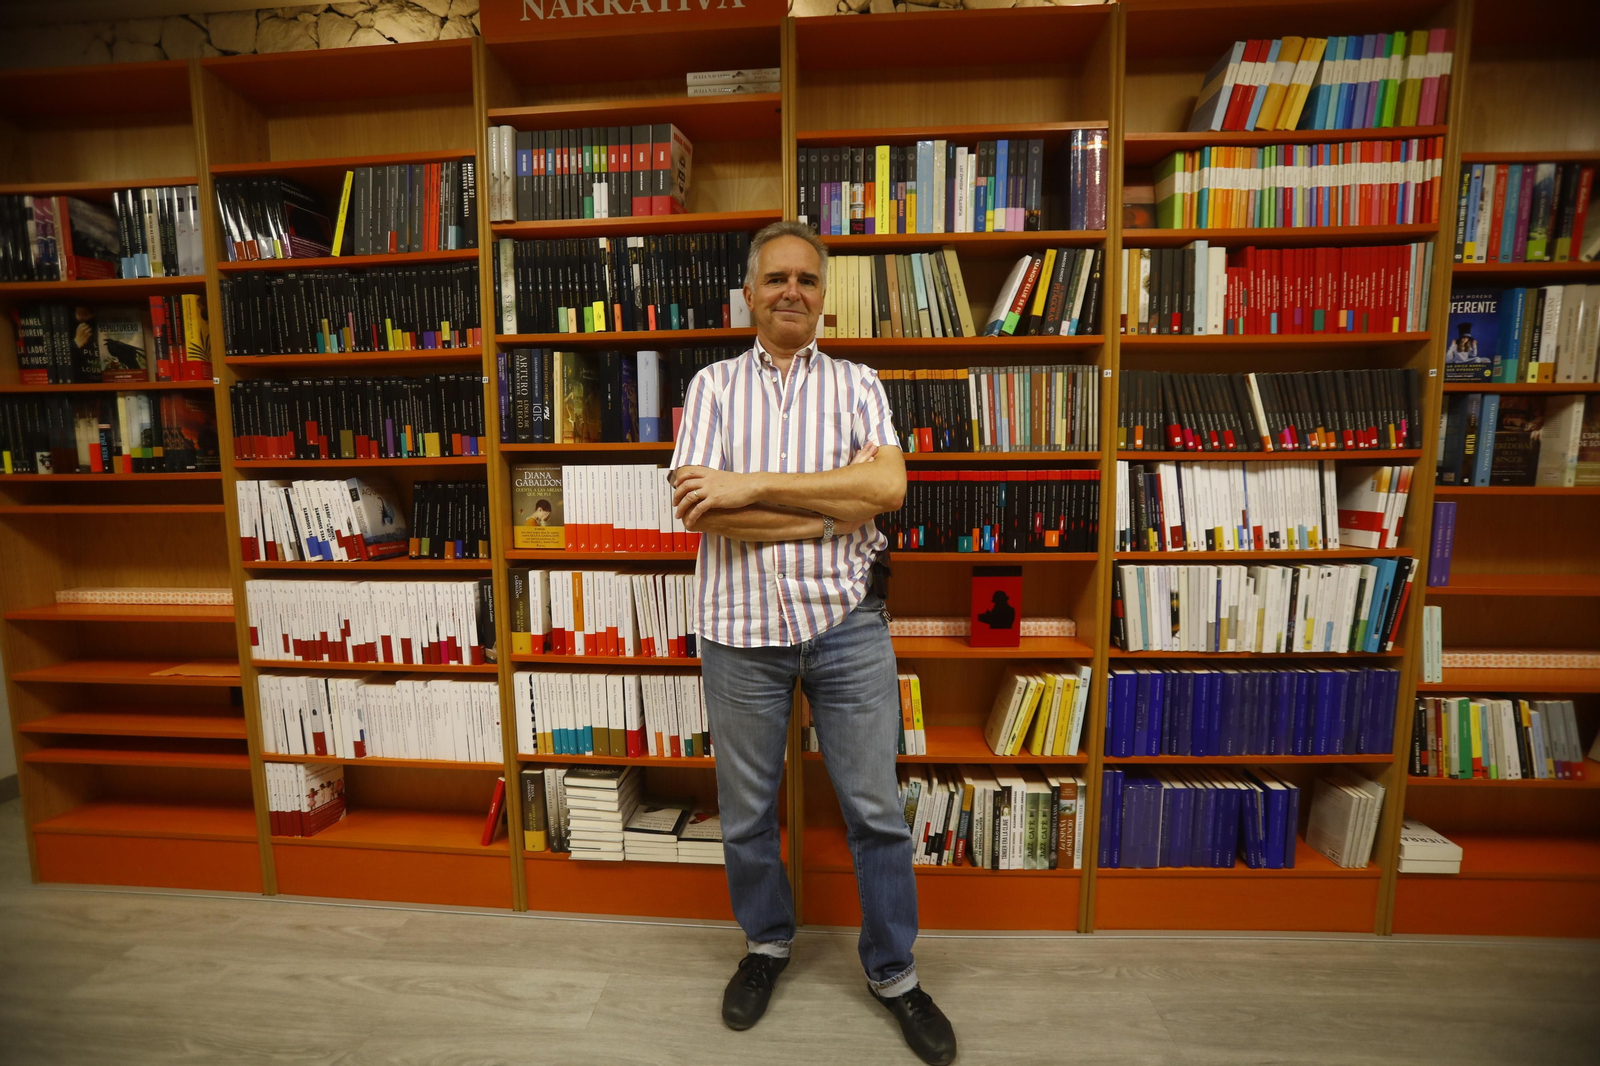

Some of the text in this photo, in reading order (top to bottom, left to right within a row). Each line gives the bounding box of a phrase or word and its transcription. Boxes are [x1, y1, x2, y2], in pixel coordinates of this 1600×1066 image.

[520, 0, 746, 21] NARRA
[1028, 258, 1041, 282] CUANDO
[1021, 283, 1031, 297] ELLIE
[1047, 283, 1060, 322] PITÁGORAS
[1450, 301, 1497, 313] FERENTE
[20, 318, 42, 326] MANEL
[99, 324, 139, 333] SEPULTURERO
[19, 329, 44, 337] LOUREIR
[520, 355, 528, 396] ARTURO
[533, 403, 542, 422] SIDI
[1465, 434, 1476, 454] MALDAD
[101, 447, 110, 461] TREN
